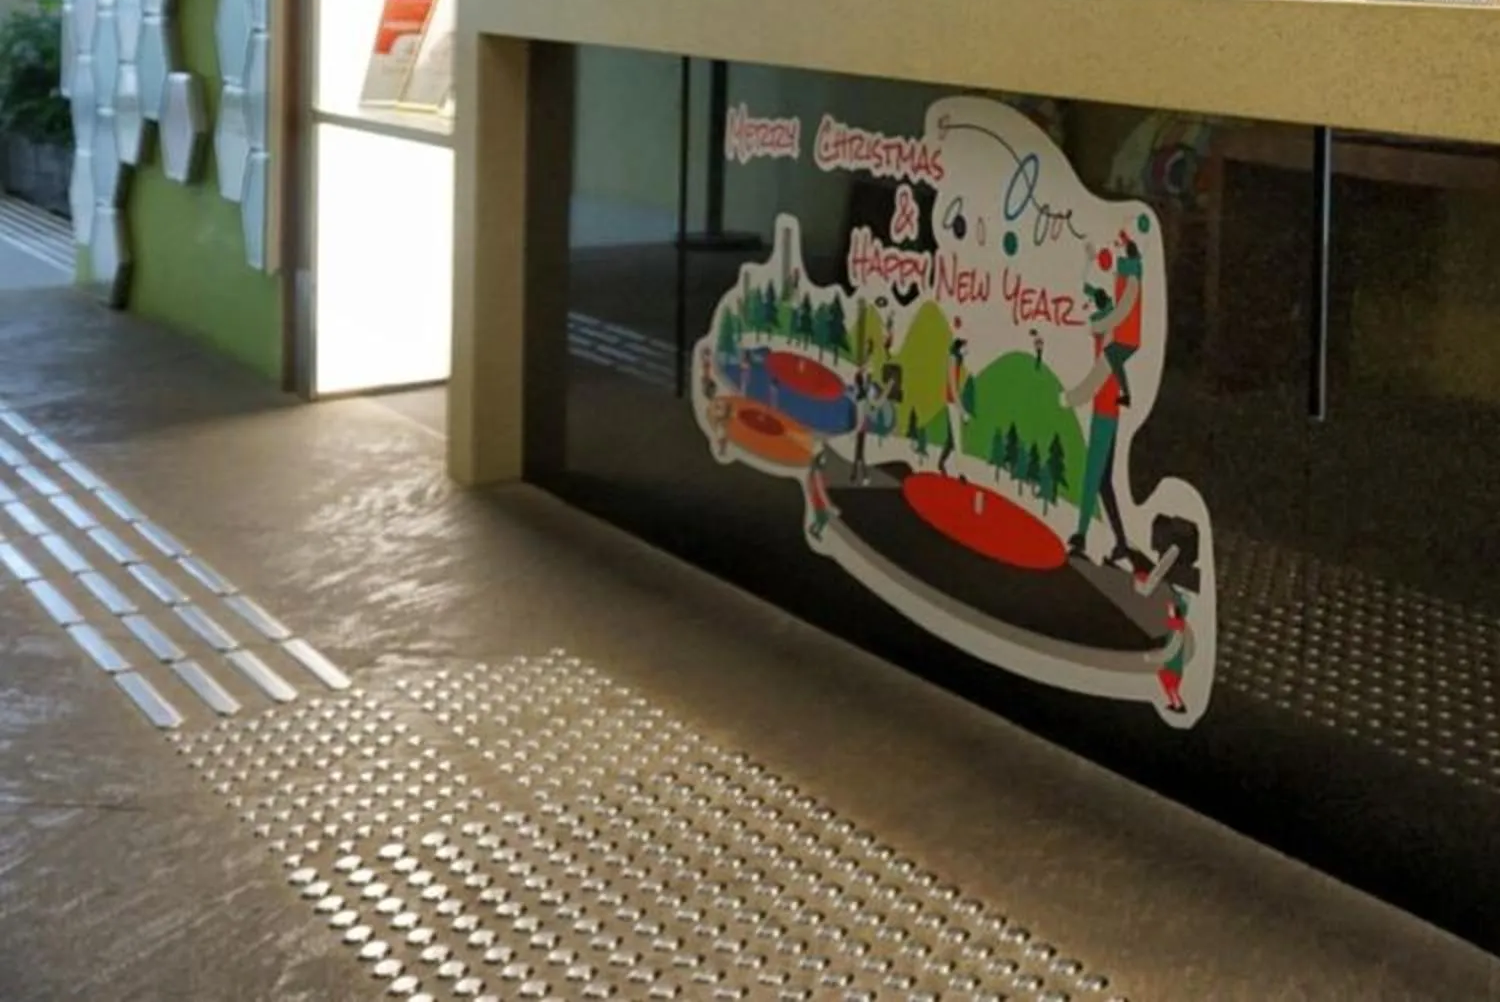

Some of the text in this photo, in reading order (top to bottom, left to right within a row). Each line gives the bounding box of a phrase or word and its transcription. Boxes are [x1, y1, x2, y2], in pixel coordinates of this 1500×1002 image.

[817, 117, 945, 181] CHRISTMAS
[893, 187, 915, 235] &
[851, 229, 1086, 327] HAPPY NEW YEAR
